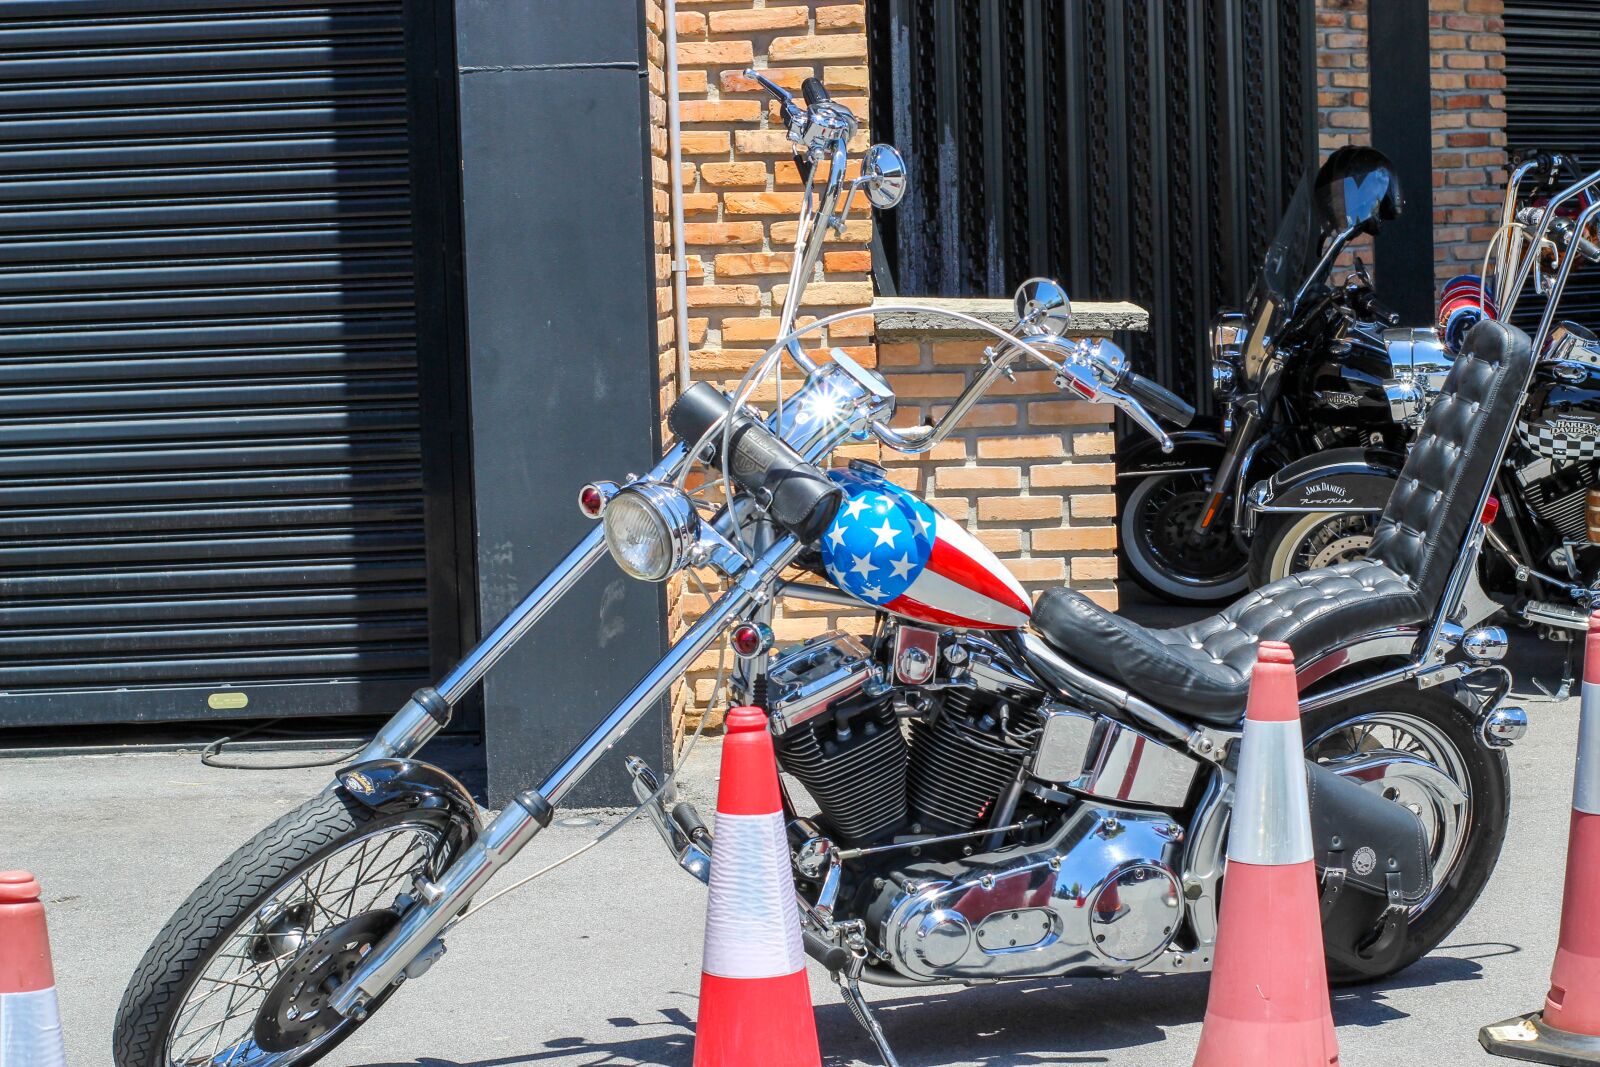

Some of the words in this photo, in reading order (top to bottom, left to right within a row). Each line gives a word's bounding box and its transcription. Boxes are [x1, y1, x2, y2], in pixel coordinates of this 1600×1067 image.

[1557, 421, 1593, 430] HARLEY
[1551, 427, 1599, 436] DAVIDSON
[1305, 484, 1322, 496] JACK
